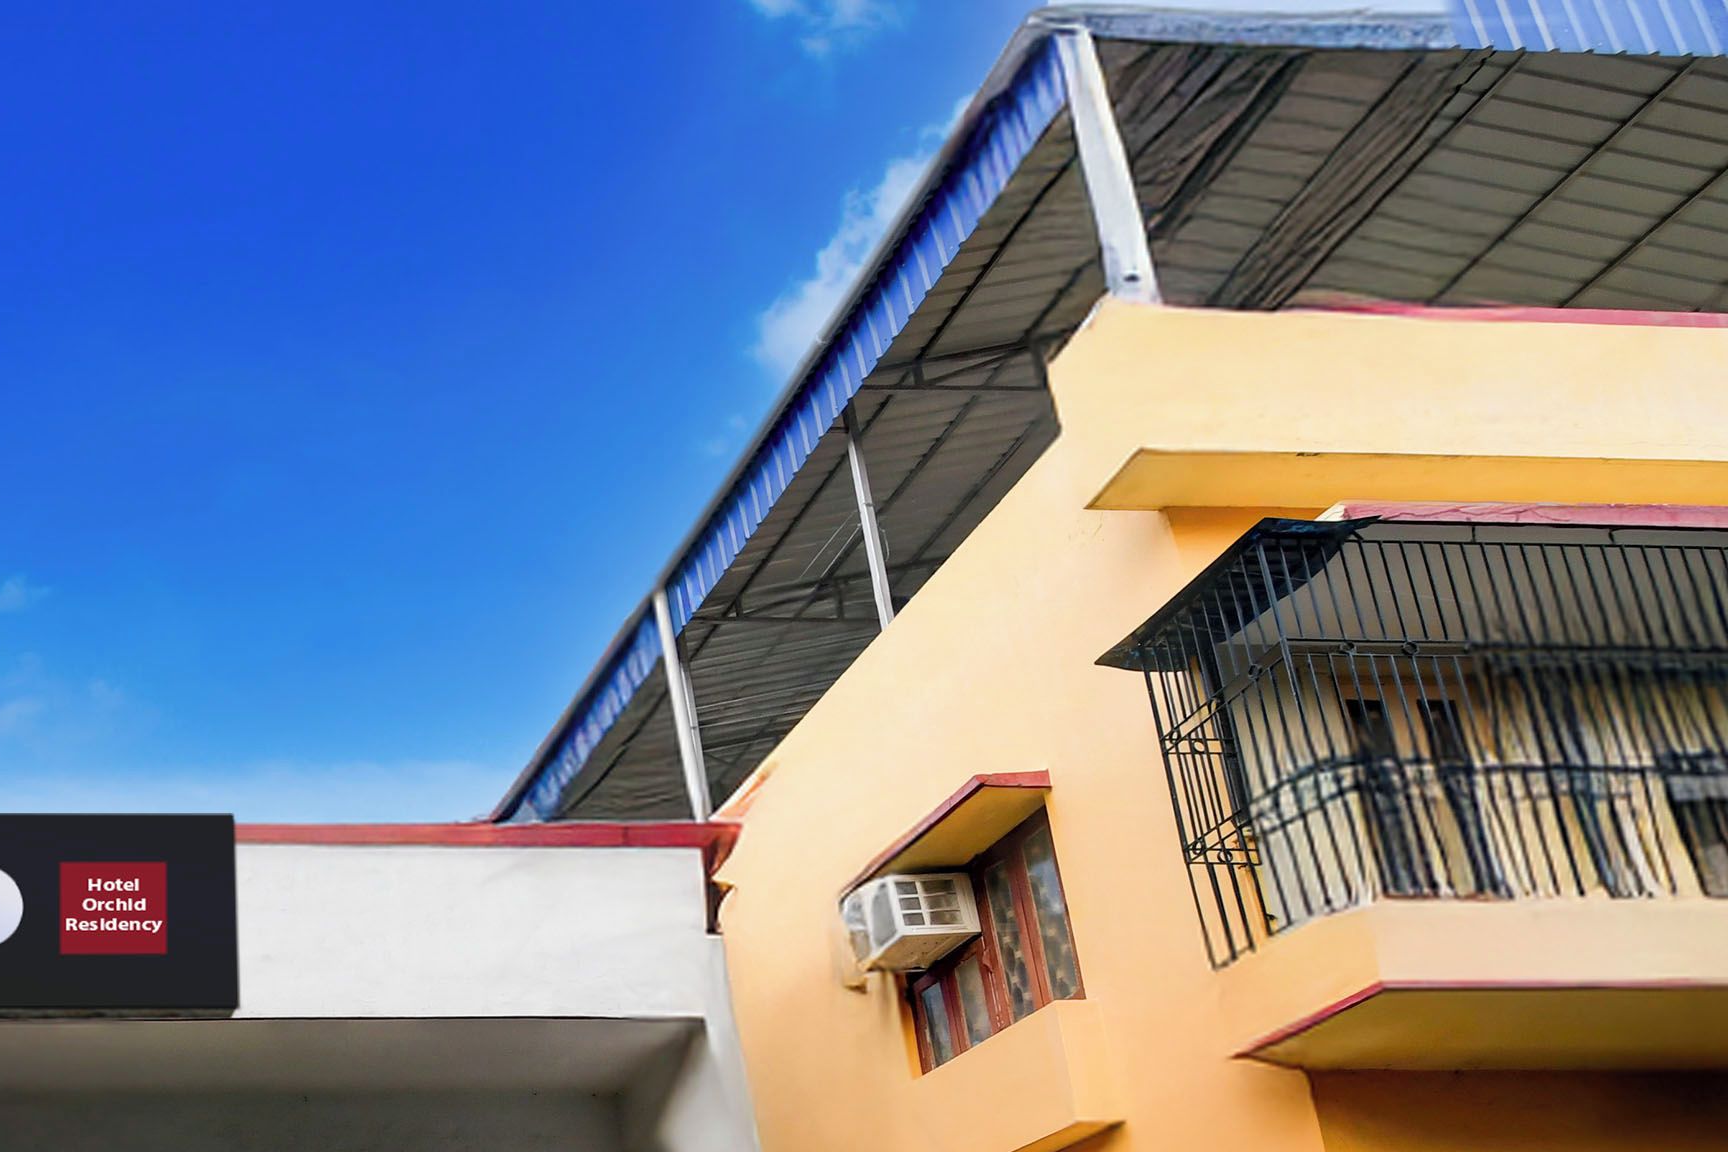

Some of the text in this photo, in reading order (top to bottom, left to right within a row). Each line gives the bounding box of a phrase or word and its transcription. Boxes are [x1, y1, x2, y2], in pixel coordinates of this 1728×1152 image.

[87, 878, 140, 891] Hotel
[82, 898, 147, 911] Orchid
[65, 918, 163, 933] Residency
